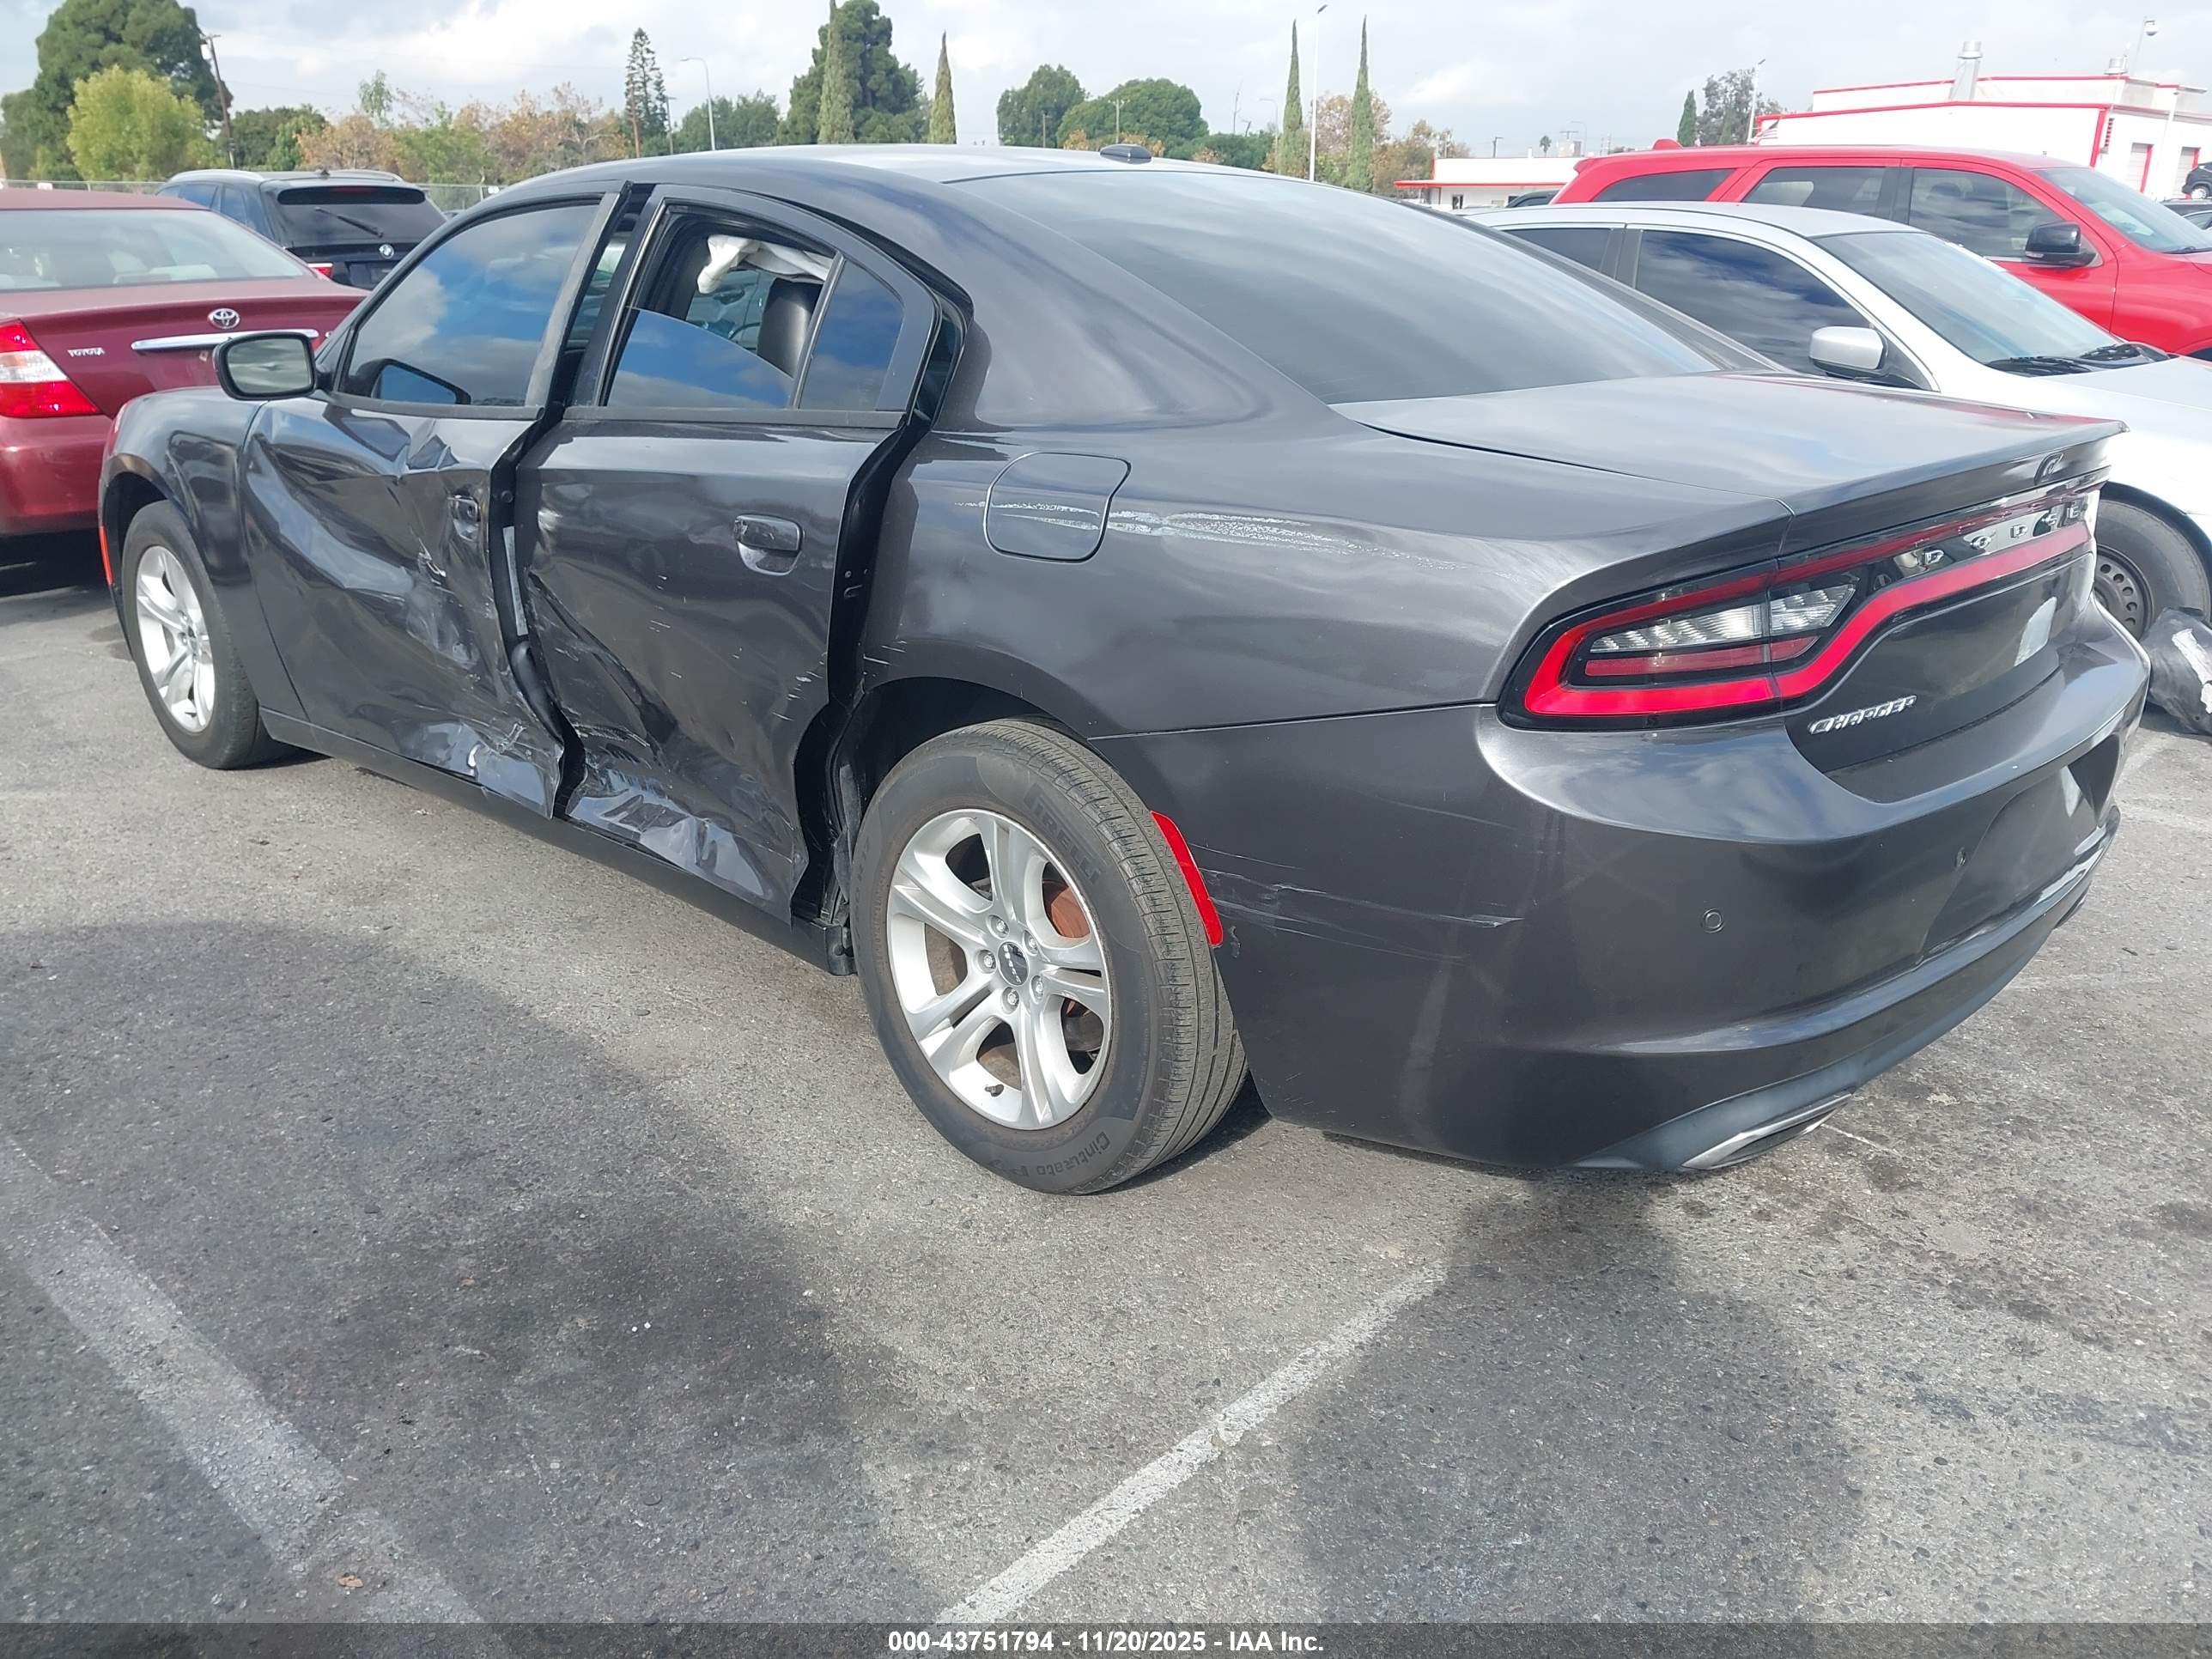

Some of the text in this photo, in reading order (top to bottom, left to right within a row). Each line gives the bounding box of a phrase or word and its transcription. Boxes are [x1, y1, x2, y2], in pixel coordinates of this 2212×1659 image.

[67, 347, 106, 357] TOYOTA
[1808, 695, 1917, 735] CHARGER
[1023, 782, 1108, 885] PIRELLI
